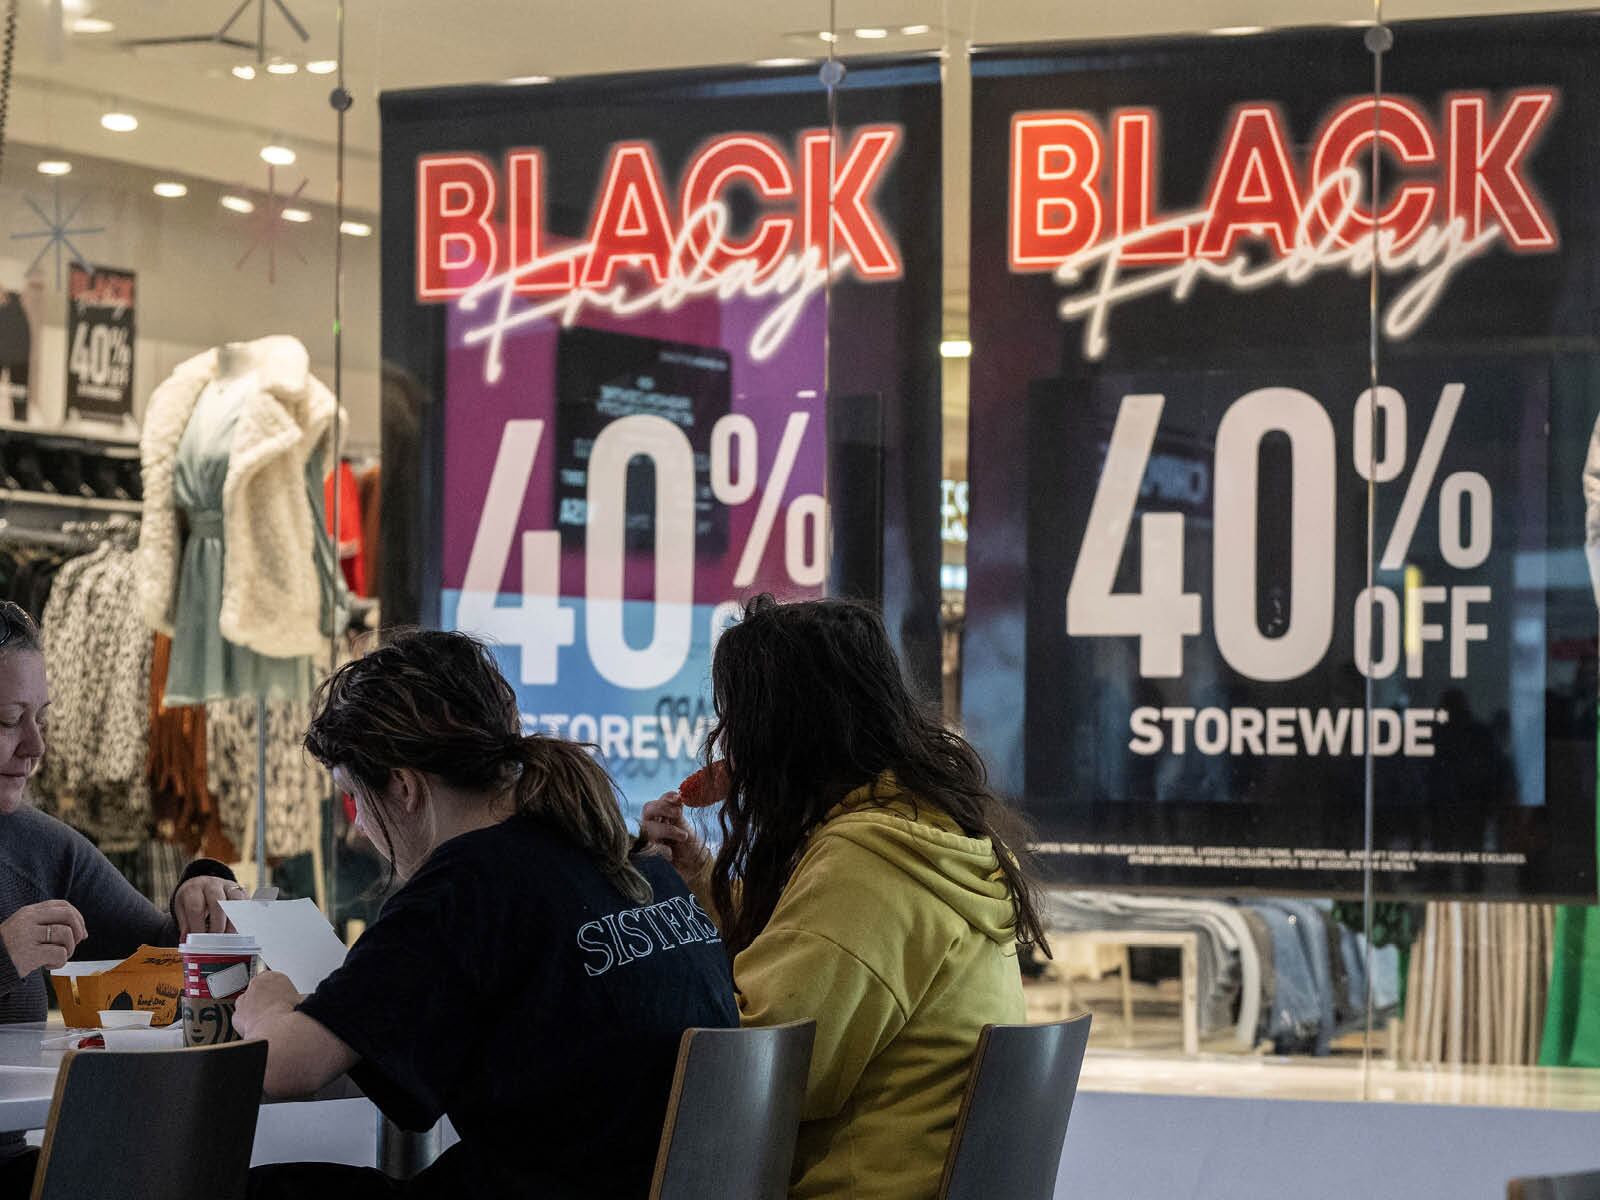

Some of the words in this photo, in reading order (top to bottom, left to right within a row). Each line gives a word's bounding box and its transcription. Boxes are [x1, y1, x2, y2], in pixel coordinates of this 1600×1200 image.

[416, 126, 902, 301] BLACK
[1010, 91, 1558, 269] BLACK
[1056, 166, 1500, 359] Friday
[458, 200, 850, 384] Friday
[455, 412, 829, 690] 40%
[1066, 383, 1492, 682] 40%
[1354, 585, 1491, 679] OFF
[576, 893, 719, 976] SISTERS
